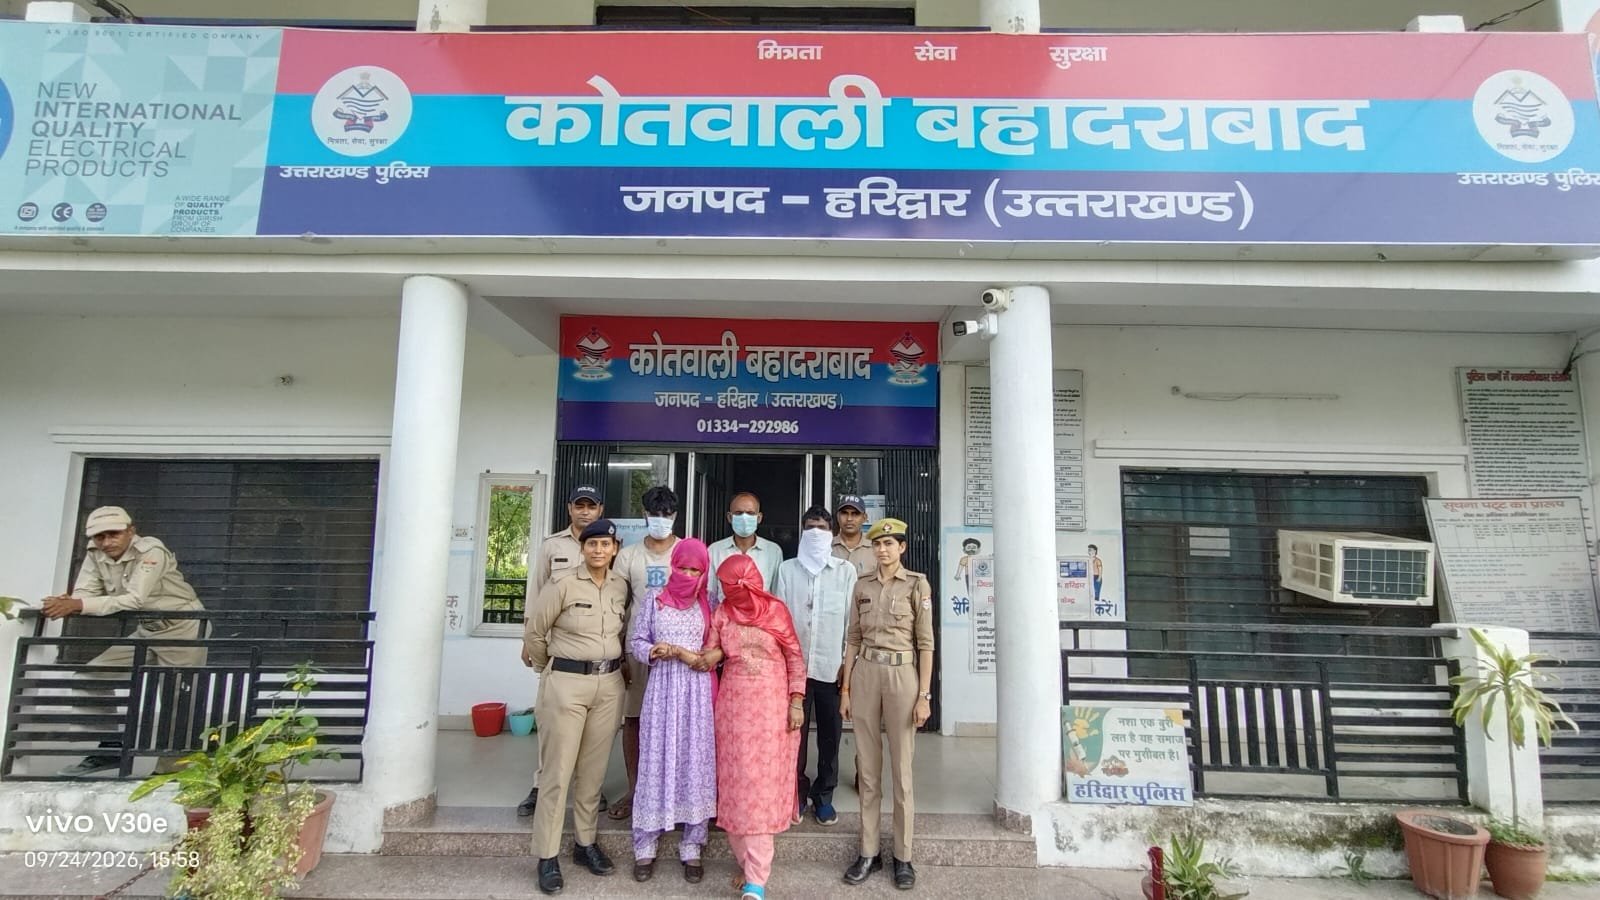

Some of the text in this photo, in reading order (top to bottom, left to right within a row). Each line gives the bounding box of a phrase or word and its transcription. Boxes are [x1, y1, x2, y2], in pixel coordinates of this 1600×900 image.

[128, 31, 197, 40] CERTIFIED
[757, 40, 823, 61] मित्रता
[914, 43, 958, 62] सेवा
[1049, 46, 1107, 69] सुरक्षा
[37, 81, 98, 99] NEW
[34, 101, 243, 121] INTERNATIONAL
[504, 74, 1369, 156] कोतवाली बहादराबाद
[31, 120, 146, 138] QUALITY
[28, 139, 187, 159] ELECTRICAL
[24, 159, 169, 178] PRODUCTS
[280, 161, 431, 184] उत्तराखण्ड पुलिस
[1456, 172, 1549, 186] उत्तराखण्ड
[620, 186, 770, 215] जनपद
[824, 176, 971, 220] हरिद्वार
[984, 178, 1254, 230] (उत्तराखण्ड)
[628, 330, 874, 383] कोतवाली बहादराबाद
[654, 391, 702, 409] जनपद
[717, 386, 759, 409] हरिद्वार
[1118, 715, 1174, 732] नशा एक बुरी
[1110, 732, 1184, 746] लत है यह समाज
[1117, 749, 1131, 760] पर
[1133, 747, 1166, 763] मुसीबत
[1073, 779, 1186, 804] हरिद्वार पुलिस
